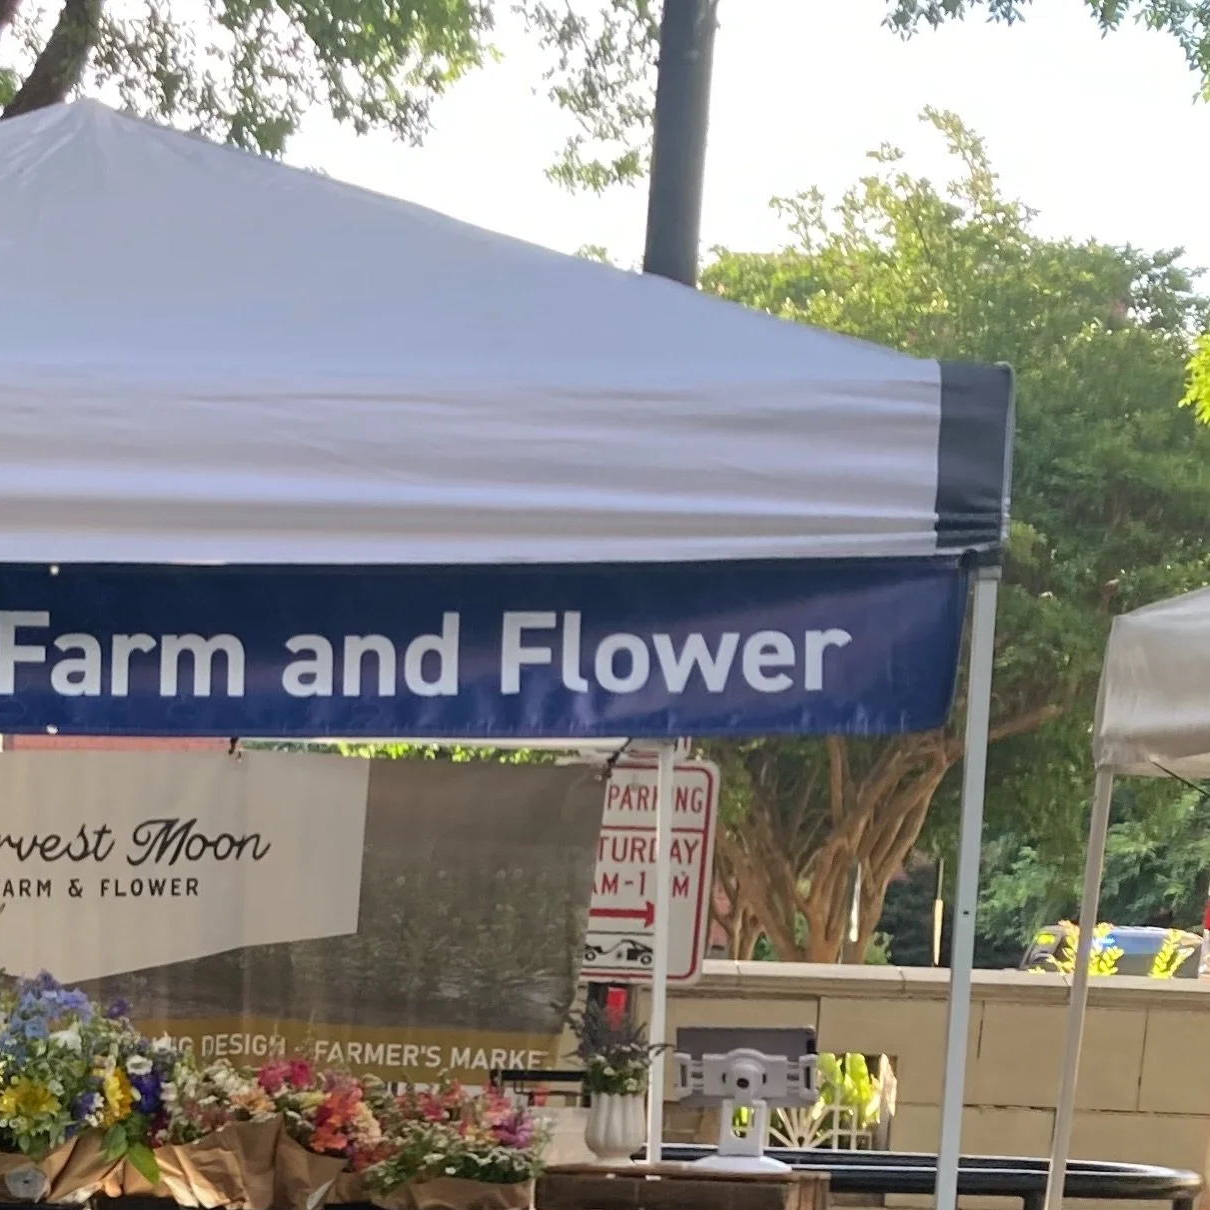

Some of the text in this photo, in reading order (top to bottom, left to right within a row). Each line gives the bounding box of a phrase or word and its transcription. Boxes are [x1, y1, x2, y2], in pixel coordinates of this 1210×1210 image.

[281, 611, 460, 697] and
[500, 611, 852, 695] Flower
[607, 785, 703, 813] PARNG
[126, 817, 272, 867] Moon
[68, 878, 83, 898] &
[100, 878, 200, 898] FLOWER
[314, 1040, 442, 1068] FARMER'S
[450, 1047, 549, 1070] MARKE
